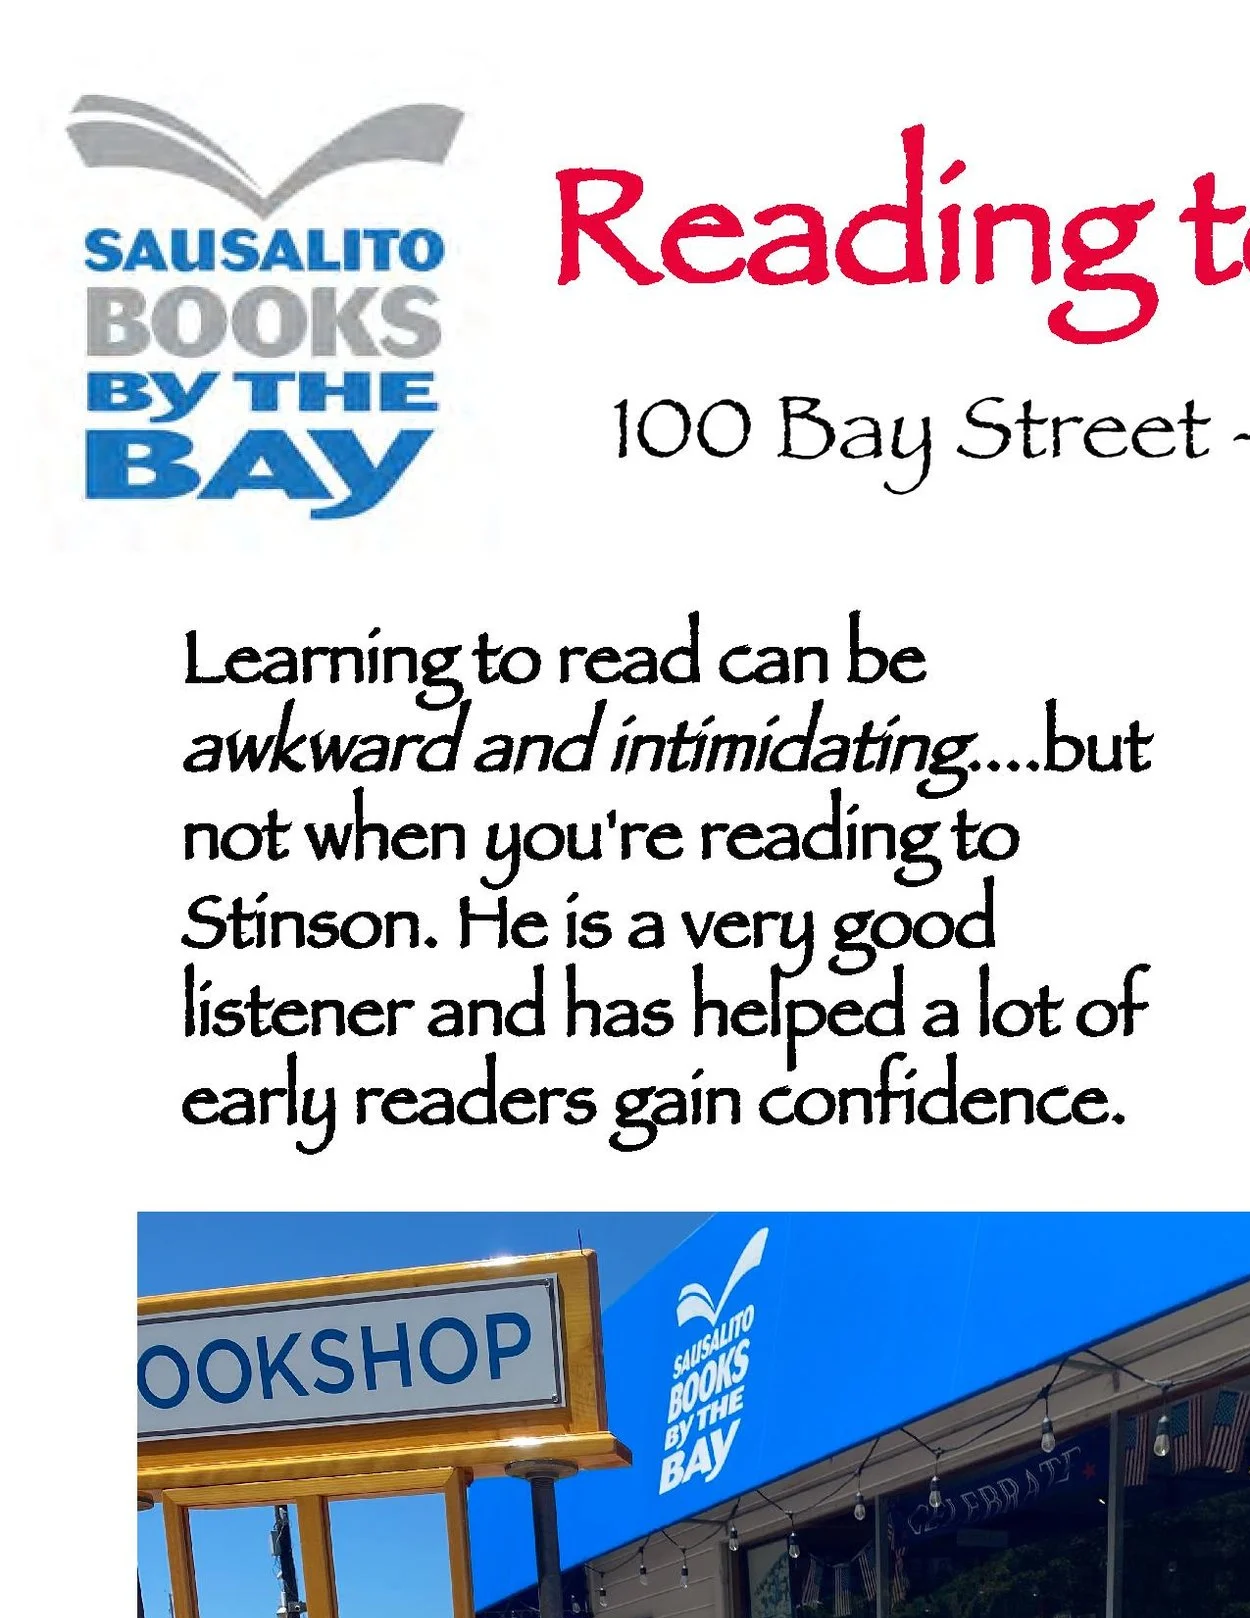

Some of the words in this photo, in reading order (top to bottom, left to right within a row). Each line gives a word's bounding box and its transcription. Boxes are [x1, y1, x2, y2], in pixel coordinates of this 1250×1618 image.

[85, 228, 445, 272] SAUSALITO
[556, 124, 1159, 345] Reading
[87, 285, 441, 358] BOOKS
[232, 371, 439, 413] THE
[614, 399, 751, 458] 100
[777, 396, 931, 495] Bay
[957, 397, 1211, 459] Street
[185, 627, 464, 711] Learning
[472, 632, 541, 684] to
[560, 611, 700, 684] read
[719, 644, 829, 684] can
[847, 610, 927, 684] be
[183, 698, 472, 772] awkward
[473, 699, 607, 774] and
[184, 809, 292, 861] not
[304, 786, 465, 861] when
[480, 810, 683, 890] you're
[701, 787, 942, 887] reading
[950, 809, 1020, 861] to
[181, 892, 437, 949] Stinson.
[460, 896, 548, 949] He
[567, 892, 612, 949] is
[628, 912, 665, 949] a
[681, 912, 813, 977] very
[828, 875, 995, 975] good
[184, 963, 415, 1037] listener
[427, 963, 545, 1037] and
[566, 963, 674, 1037] has
[692, 963, 905, 1071] helped
[922, 1000, 959, 1037] a
[979, 963, 1064, 1037] lot
[1076, 963, 1151, 1037] of
[182, 1051, 336, 1155] early
[356, 1052, 597, 1125] readers
[609, 1068, 740, 1152] gain
[759, 1052, 1125, 1125] confidence.
[137, 1312, 531, 1409] OOKSHOP
[667, 1338, 750, 1424] BOOKS
[673, 1304, 754, 1379] SAUSALITO
[697, 1385, 745, 1430] THE
